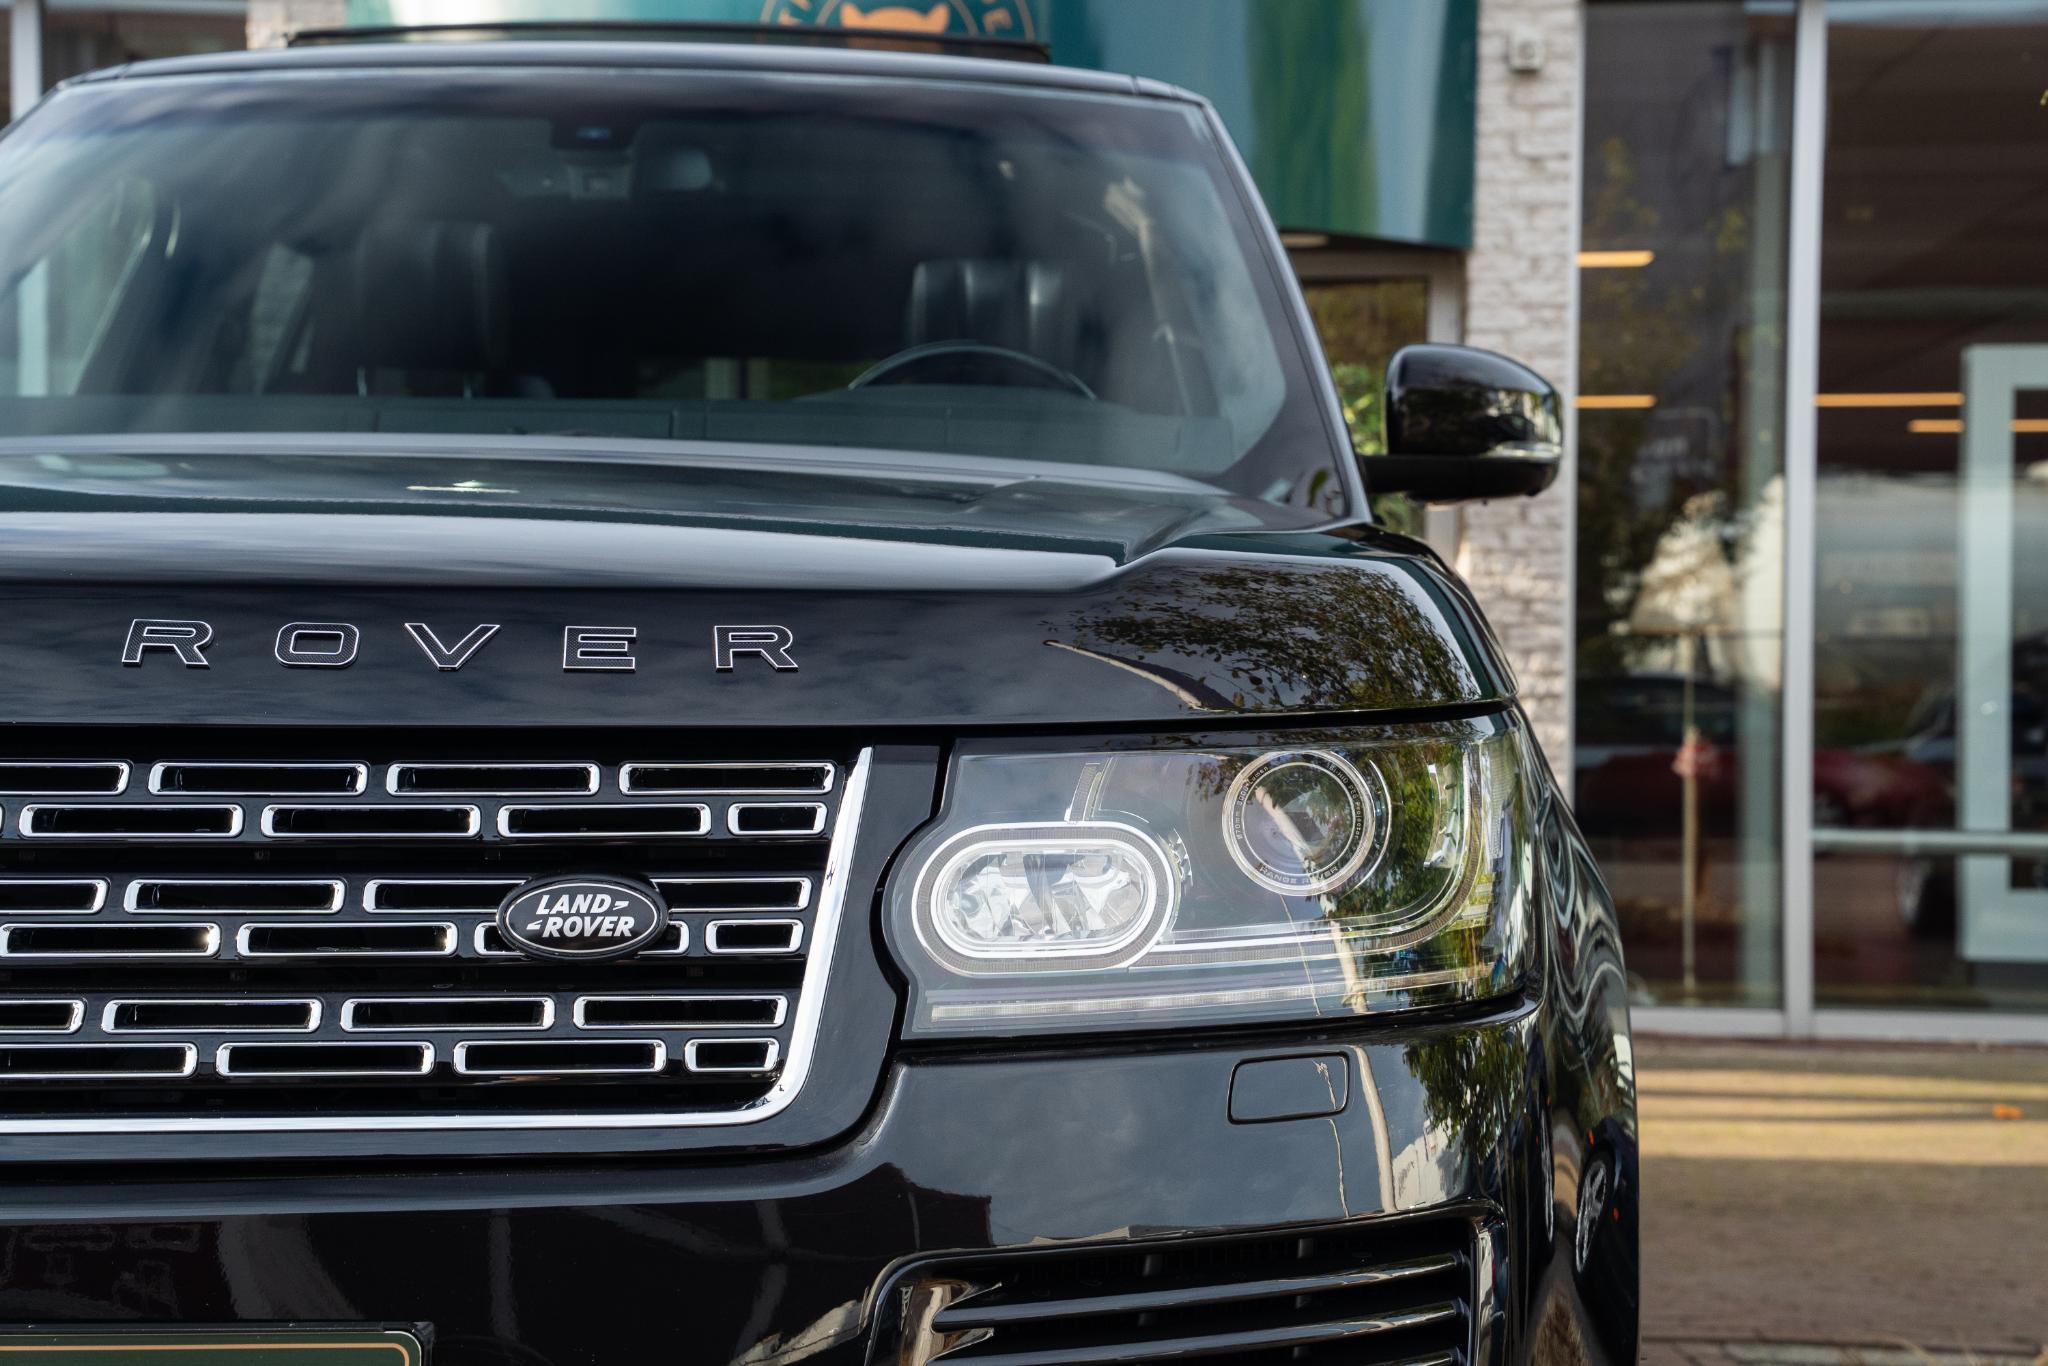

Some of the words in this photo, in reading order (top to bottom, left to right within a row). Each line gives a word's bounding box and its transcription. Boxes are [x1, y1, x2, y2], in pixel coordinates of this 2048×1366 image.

[121, 618, 799, 672] ROVER
[1259, 866, 1297, 885] RANGE
[535, 893, 612, 915] LAND
[542, 915, 635, 938] ROVER
